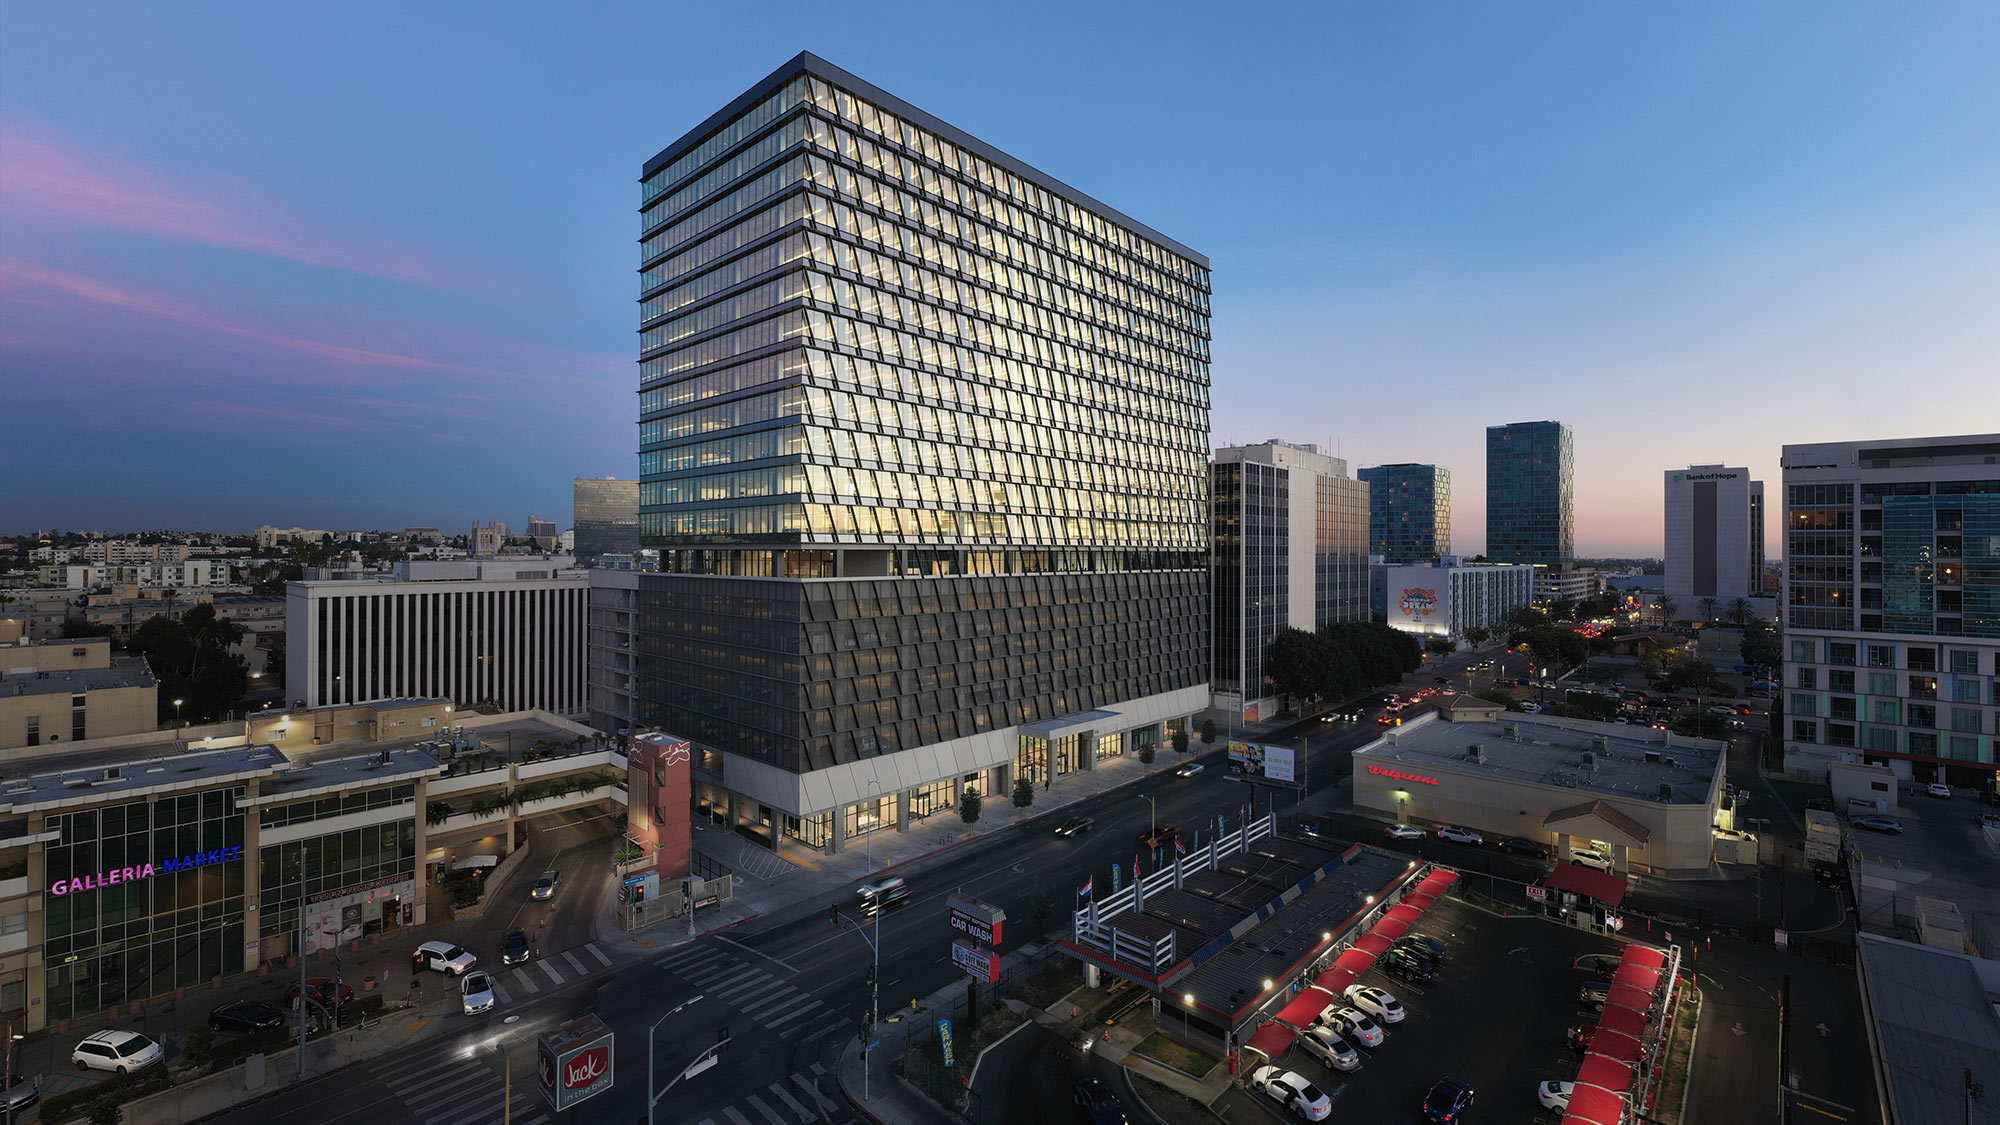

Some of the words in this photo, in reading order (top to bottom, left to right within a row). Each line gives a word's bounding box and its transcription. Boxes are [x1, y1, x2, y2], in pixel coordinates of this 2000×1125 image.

[1686, 473, 1705, 481] Bank
[1367, 764, 1441, 786] Walgreens
[51, 862, 156, 896] GALLERIA
[163, 845, 242, 873] MARKET
[346, 883, 371, 896] TOMS
[1528, 887, 1544, 896] EXIT
[951, 916, 967, 932] CAR
[968, 923, 993, 943] WASH
[940, 1022, 951, 1042] CAR
[565, 1054, 607, 1088] Jack
[564, 1095, 573, 1103] in
[575, 1086, 591, 1098] the
[592, 1077, 609, 1091] box
